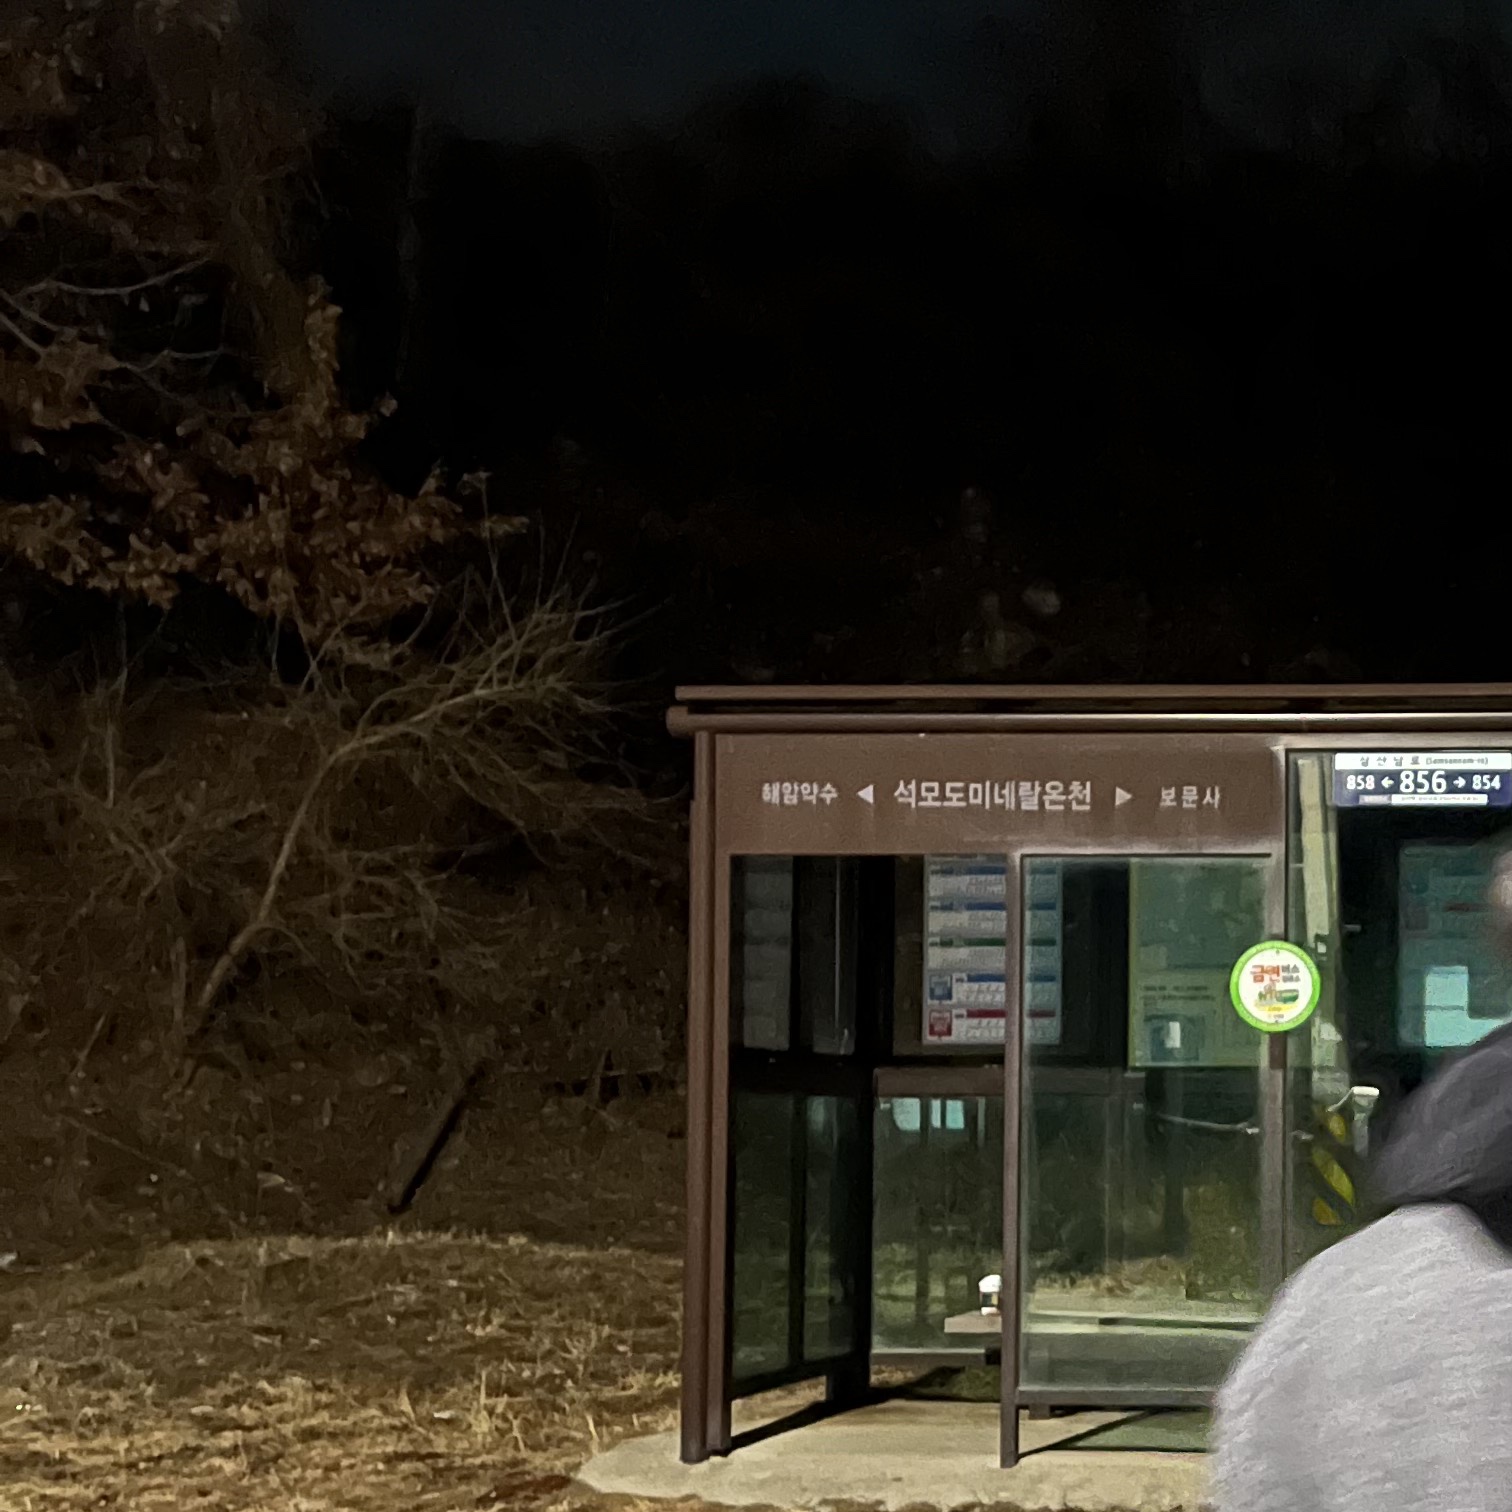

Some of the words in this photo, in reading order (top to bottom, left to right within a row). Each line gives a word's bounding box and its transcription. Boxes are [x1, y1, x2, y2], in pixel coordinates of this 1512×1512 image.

[893, 778, 1092, 810] 석모도미네랄온천
[1158, 785, 1221, 809] 보문사
[1346, 774, 1375, 790] 858
[1399, 770, 1447, 793] 856
[1471, 774, 1501, 790] 854
